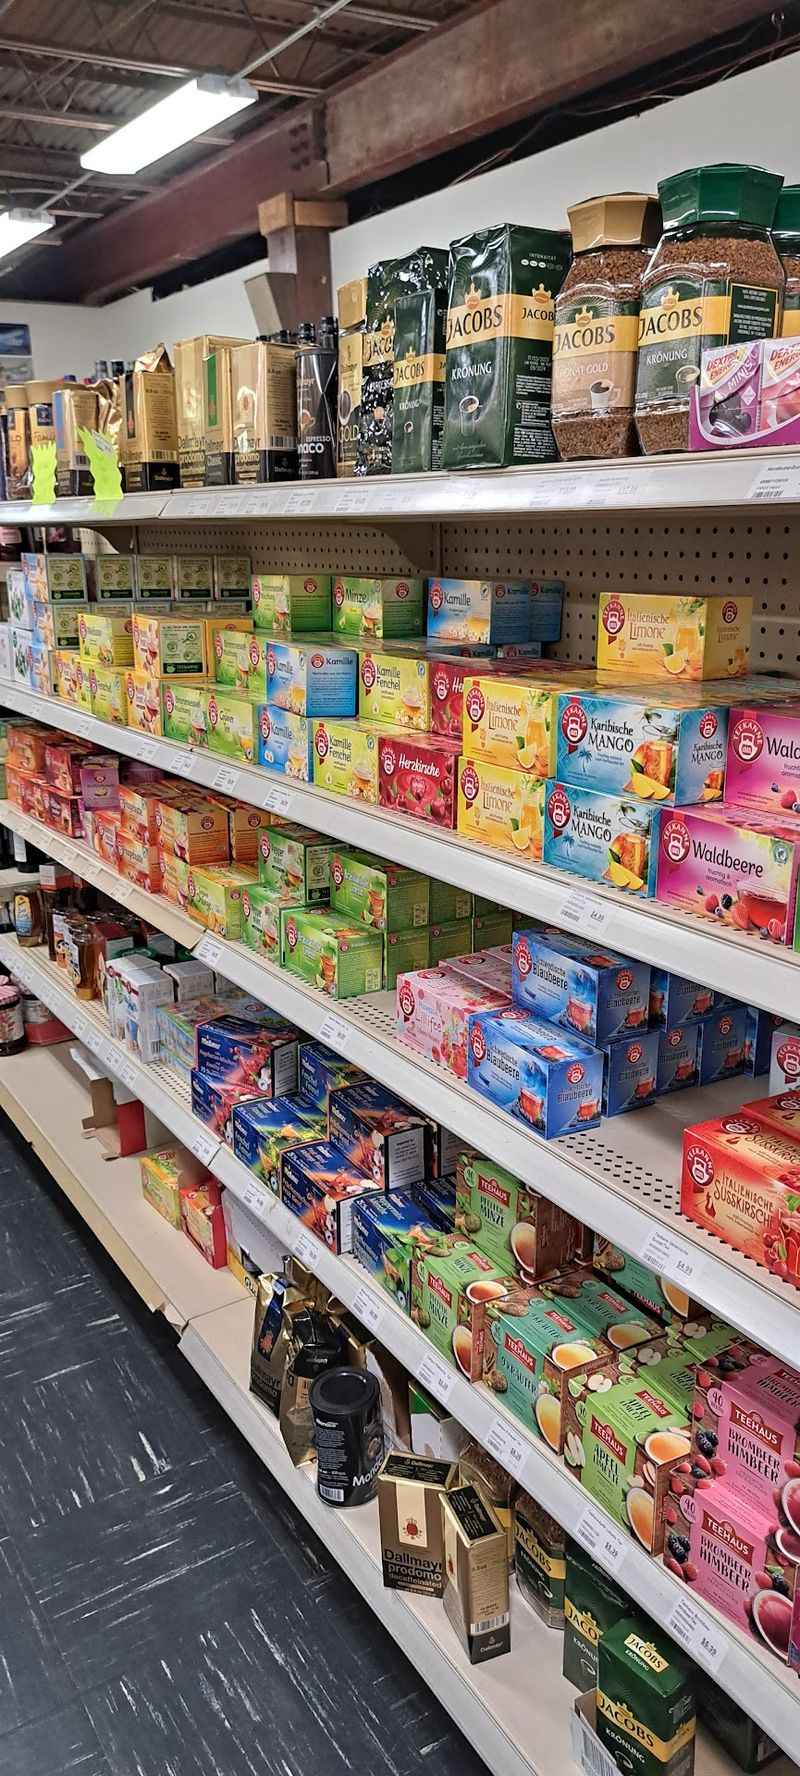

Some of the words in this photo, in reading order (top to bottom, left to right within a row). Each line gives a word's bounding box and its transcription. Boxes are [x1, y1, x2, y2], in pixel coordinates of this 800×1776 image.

[447, 304, 503, 343] JACOBS
[639, 306, 703, 340] JACOBS
[553, 324, 615, 354] JACOBS
[646, 349, 688, 366] KRÖNUNG
[394, 360, 425, 386] JACOBS
[451, 361, 492, 382] KRÖNUNG
[444, 592, 471, 606] Kamille
[627, 608, 670, 625] Italienische
[630, 623, 666, 640] Limone
[326, 657, 353, 666] Kamille
[376, 665, 400, 679] Kamille
[376, 677, 400, 691] Fenchel
[489, 714, 518, 731] Limone
[591, 718, 634, 736] Karibische
[733, 720, 763, 746] TEEKANNE
[330, 735, 352, 751] Kamille
[588, 733, 634, 753] MANGO
[399, 753, 440, 778] Herzkirsche
[691, 750, 723, 764] MANGO
[483, 793, 513, 814] Limone
[573, 804, 611, 827] Karibische
[571, 821, 612, 842] MANGO
[692, 839, 764, 878] Waldbeere
[532, 962, 568, 991] Blaubeere
[486, 1050, 520, 1081] Blaubeere
[722, 1174, 774, 1212] ITALIENISCHE
[480, 1206, 504, 1228] MINZE
[507, 1337, 534, 1367] TEEHAUS
[594, 1420, 625, 1457] TEEHAUS
[735, 1410, 778, 1445] TEEHAUS
[594, 1444, 619, 1474] APFEL
[727, 1439, 780, 1483] HIMBEER
[728, 1428, 781, 1471] BROMBEER
[685, 1498, 696, 1513] 40
[707, 1517, 749, 1555] TEEHAUS
[384, 1549, 443, 1573] Dallmayr
[700, 1535, 752, 1579] BROMBEER
[388, 1563, 442, 1581] prodomo
[389, 1573, 442, 1589] decaffeinated
[699, 1548, 750, 1593] HIMBEER
[627, 1638, 663, 1669] JACOBS
[598, 1696, 655, 1748] JACOBS
[605, 1728, 645, 1763] KRÖNUNG
